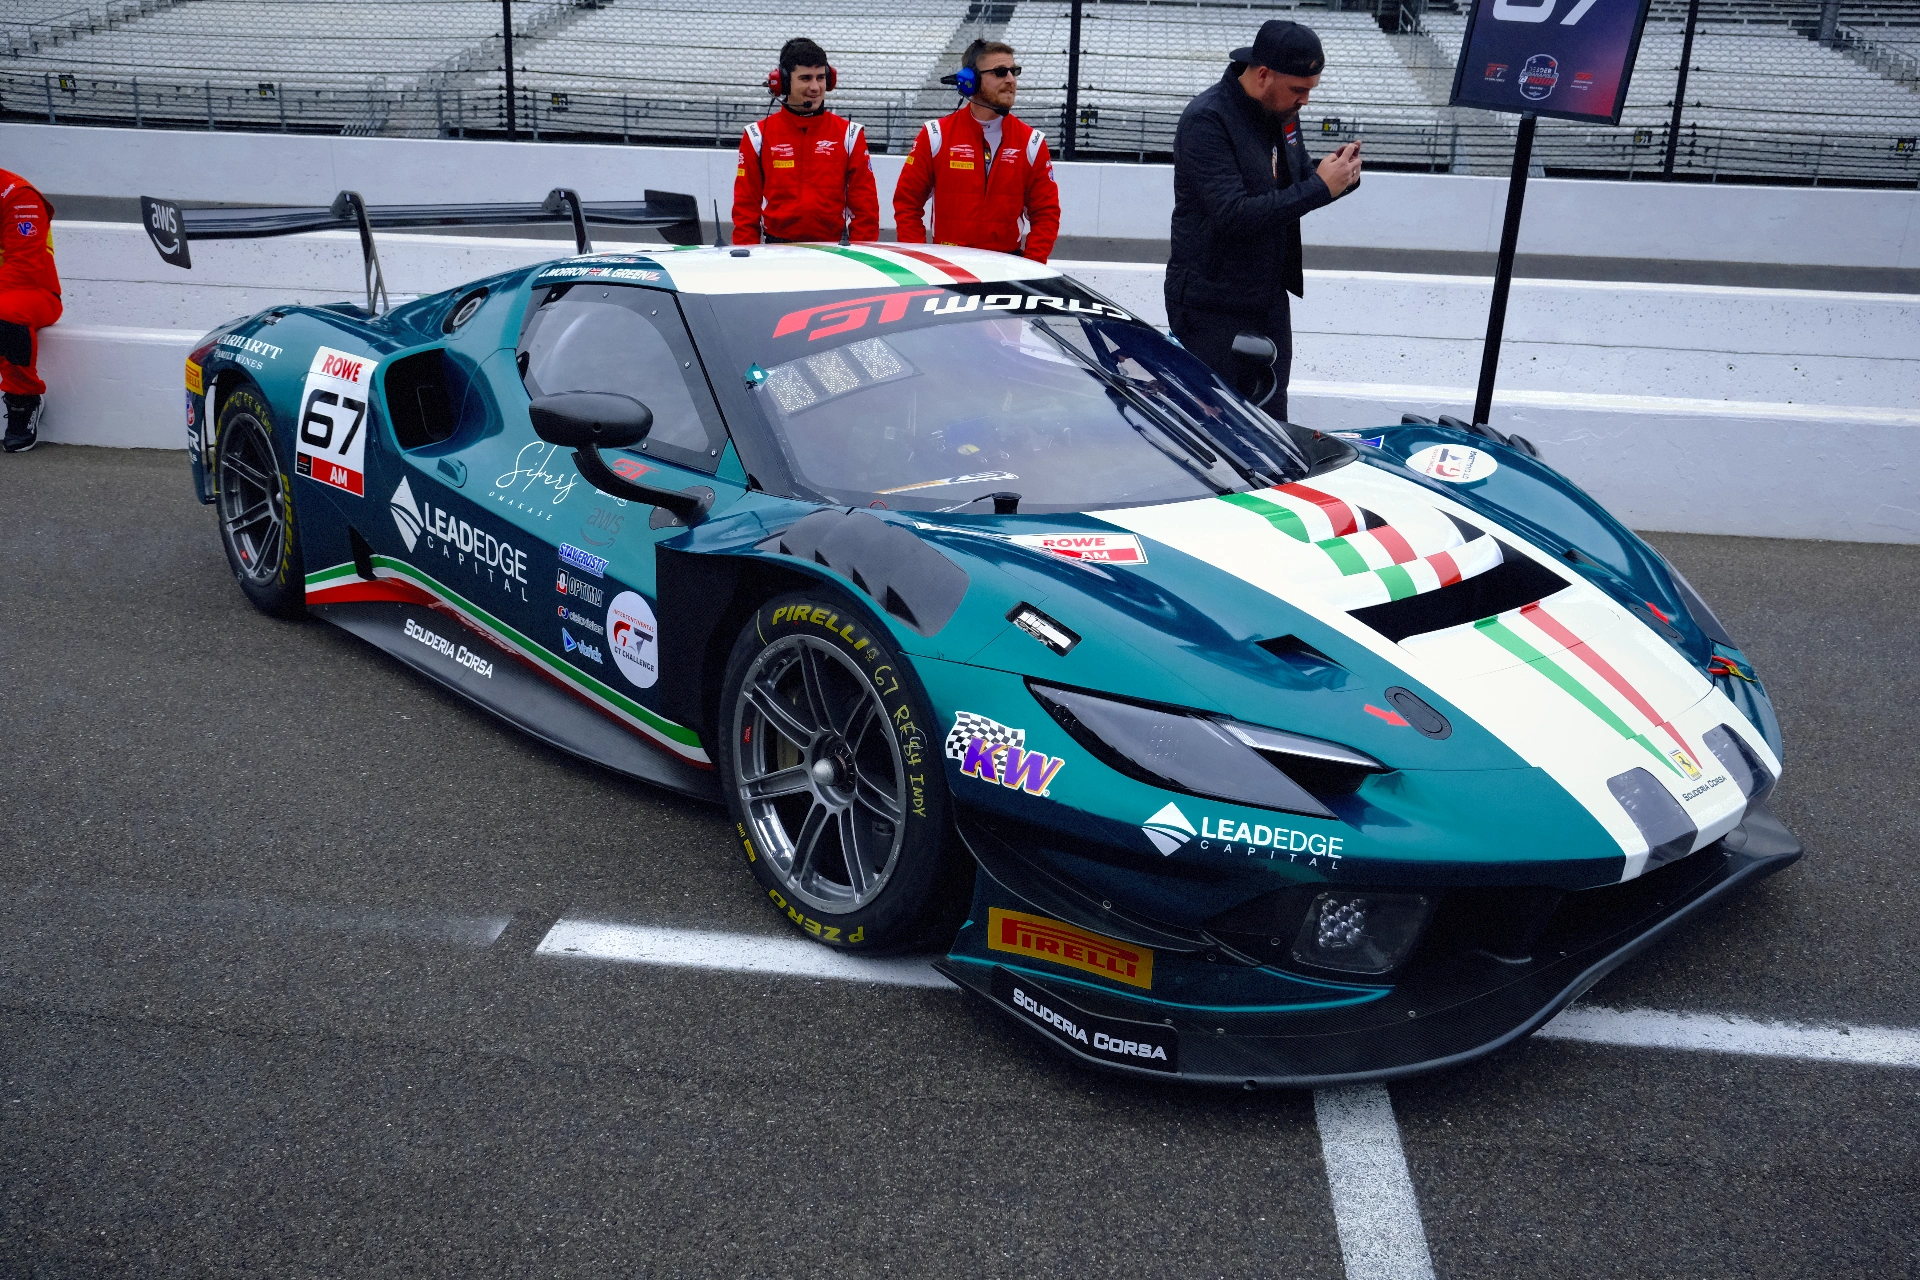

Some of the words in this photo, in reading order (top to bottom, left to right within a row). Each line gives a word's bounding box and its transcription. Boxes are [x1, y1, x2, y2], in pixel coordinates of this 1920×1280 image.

[151, 203, 177, 233] aws
[611, 269, 649, 280] GREEN
[773, 289, 945, 341] GT
[217, 334, 283, 359] CARHARTT
[235, 353, 263, 370] WINES
[322, 354, 363, 382] ROWE
[301, 389, 365, 455] 67
[330, 466, 347, 487] AM
[489, 490, 552, 521] OMAKASE
[586, 507, 625, 535] aws
[425, 502, 527, 584] LEADEDGE
[1042, 537, 1105, 547] ROWE
[1081, 551, 1110, 560] AM
[427, 536, 528, 602] CAPITAL
[559, 543, 578, 560] STAY
[577, 550, 609, 573] FROSTY
[772, 605, 870, 650] PIRELLI
[403, 618, 453, 659] SCUDERIA
[455, 645, 493, 679] CORSA
[622, 648, 655, 672] CHALLENGE
[874, 665, 899, 696] 67
[909, 773, 926, 818] INDY
[961, 735, 1065, 796] KW
[1201, 816, 1344, 859] LEADEDGE
[1200, 840, 1338, 870] CAPITAL
[769, 889, 841, 942] ZERO
[848, 926, 865, 942] P
[1001, 917, 1139, 978] PIRELLI
[1013, 988, 1088, 1044] SCUDERIA
[1093, 1032, 1167, 1061] CORSA
